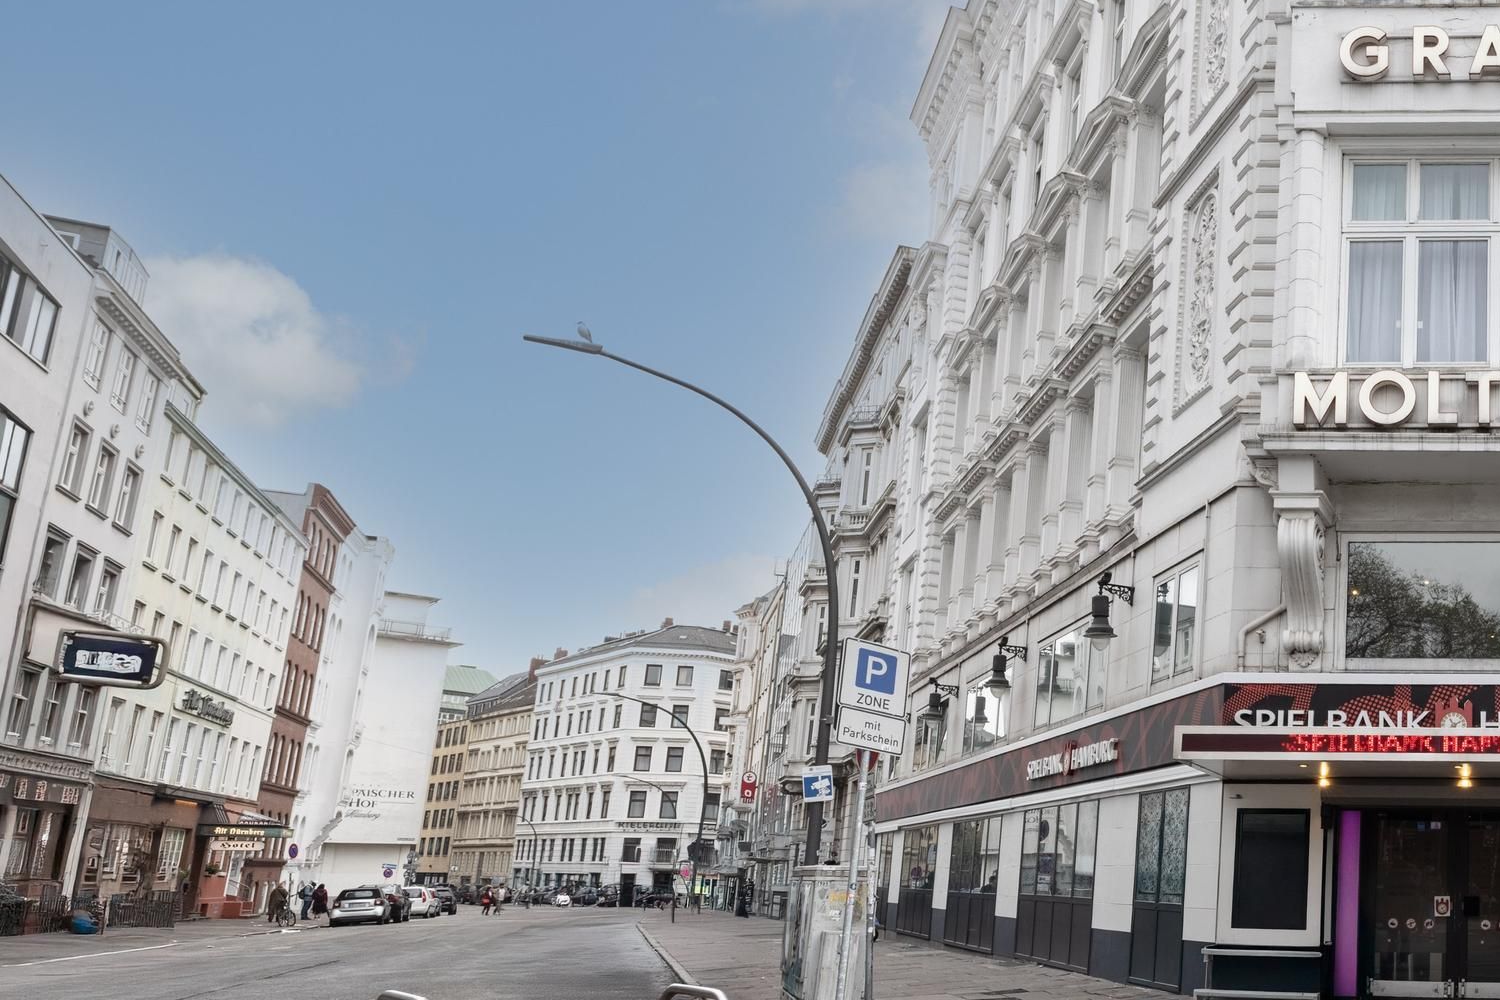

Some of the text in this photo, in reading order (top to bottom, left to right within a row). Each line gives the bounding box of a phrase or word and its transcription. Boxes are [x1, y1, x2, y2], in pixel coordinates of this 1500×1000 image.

[865, 655, 888, 685] P
[856, 693, 890, 710] ZONE
[864, 721, 881, 731] mit
[1234, 709, 1431, 728] SPIELBANK
[842, 726, 899, 747] Parkschein
[1070, 738, 1119, 770] HAMBURG
